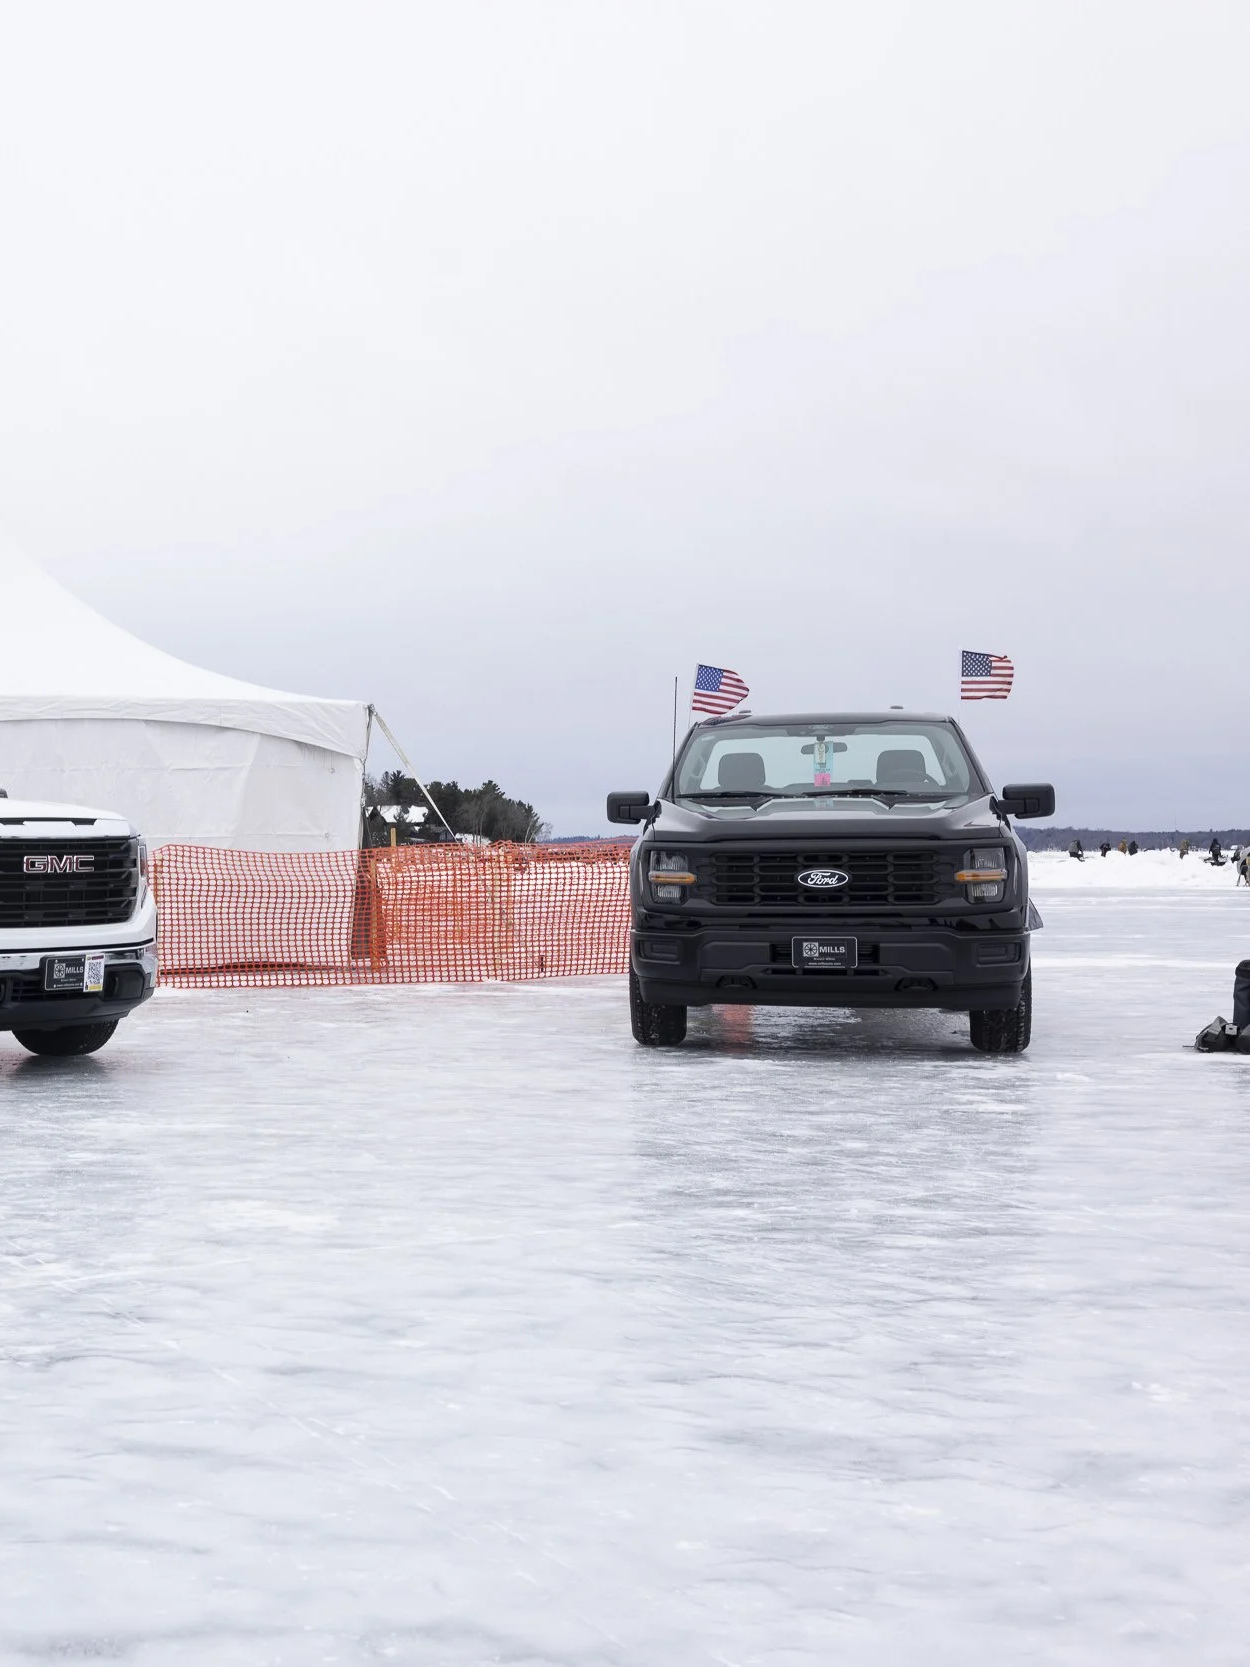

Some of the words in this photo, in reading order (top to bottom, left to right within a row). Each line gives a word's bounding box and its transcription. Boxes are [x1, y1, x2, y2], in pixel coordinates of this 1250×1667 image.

[23, 855, 94, 873] GMC
[807, 872, 839, 885] Ford
[65, 965, 84, 975] MILLS
